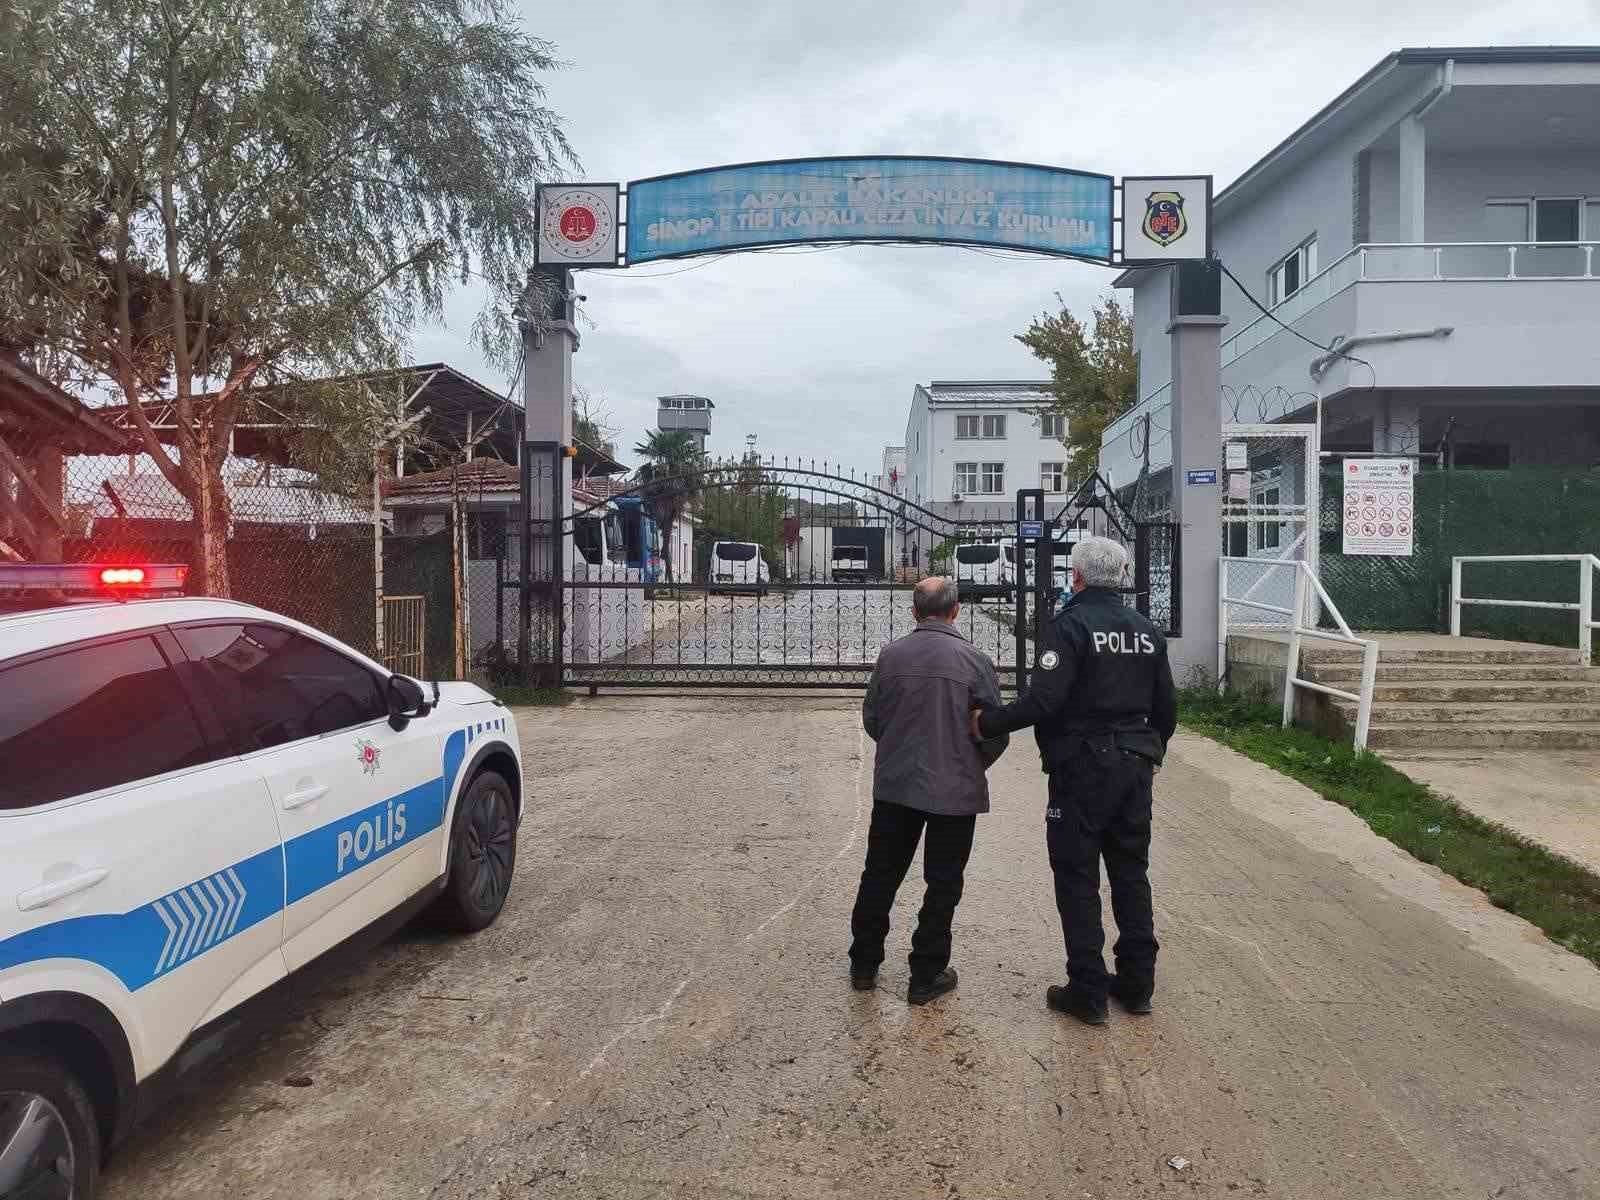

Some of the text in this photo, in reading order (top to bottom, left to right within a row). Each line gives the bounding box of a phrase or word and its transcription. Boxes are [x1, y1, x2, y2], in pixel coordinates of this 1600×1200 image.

[646, 216, 713, 241] SİNOP
[737, 208, 775, 230] TİPİ
[781, 207, 856, 228] KAPALI
[998, 209, 1096, 241] KURUMU
[1093, 631, 1155, 654] POLİS
[337, 799, 407, 873] POLİS
